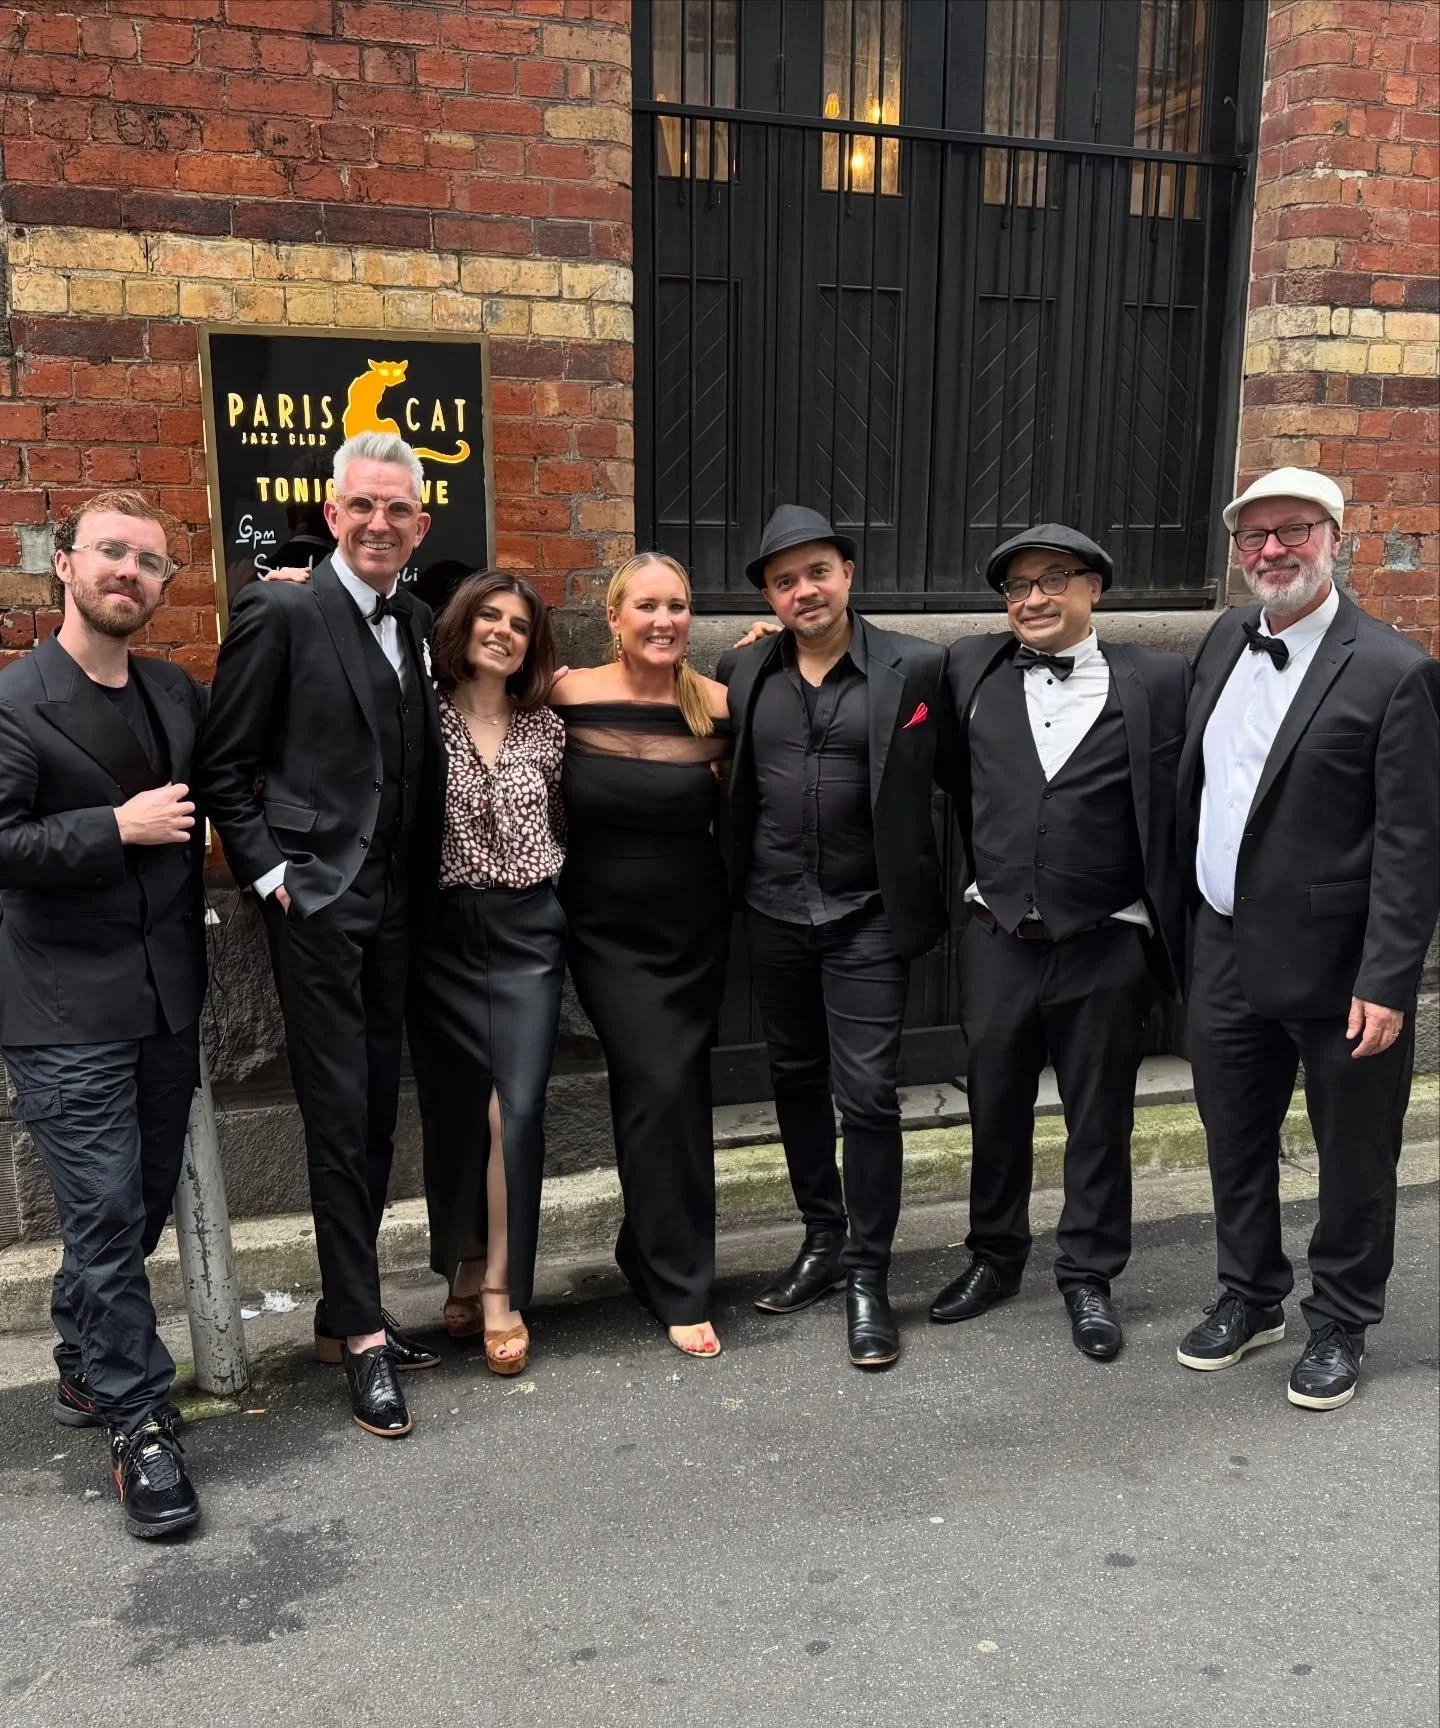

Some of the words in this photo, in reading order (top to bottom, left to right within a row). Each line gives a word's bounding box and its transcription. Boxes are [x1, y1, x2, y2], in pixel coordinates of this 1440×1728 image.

[227, 392, 333, 429] PARIS
[405, 397, 466, 433] CAT
[241, 432, 279, 445] JAZZ
[288, 432, 327, 446] CLUB
[256, 477, 337, 502] TONIG
